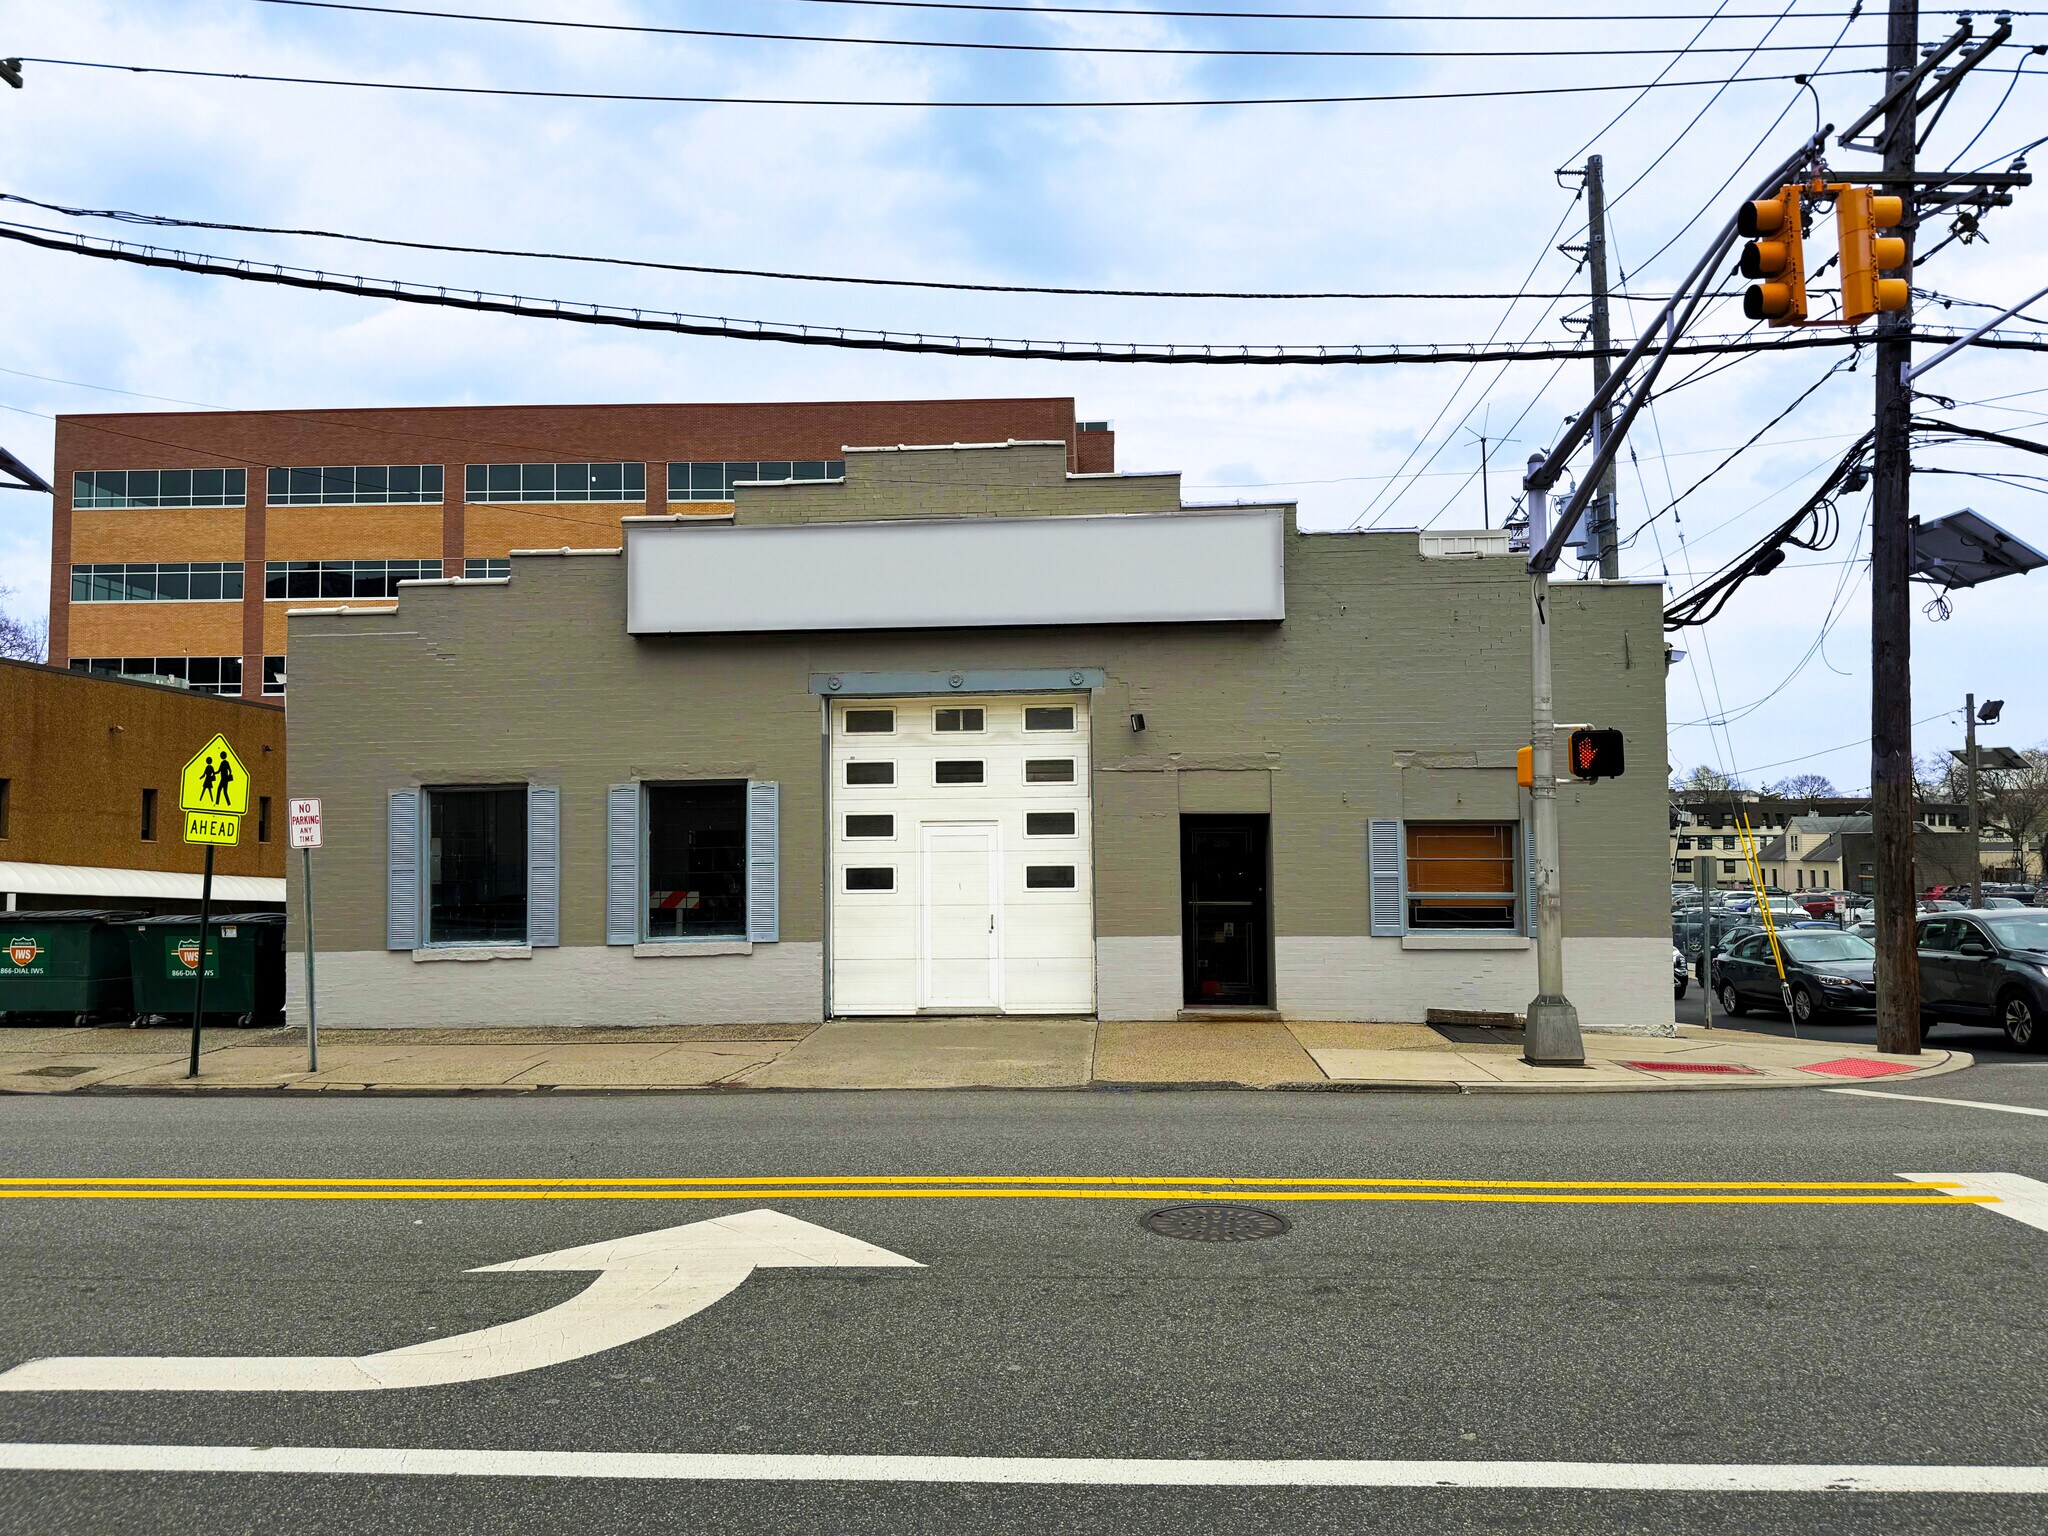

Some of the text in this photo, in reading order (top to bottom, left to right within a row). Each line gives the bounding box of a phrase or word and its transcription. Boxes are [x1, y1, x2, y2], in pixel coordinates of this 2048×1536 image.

[298, 803, 311, 813] NO
[292, 815, 320, 826] PARKING
[190, 819, 235, 837] AHEAD
[299, 835, 314, 843] TIME
[15, 949, 31, 960] IWS
[184, 951, 199, 962] IWS
[171, 969, 198, 977] 866-DIA
